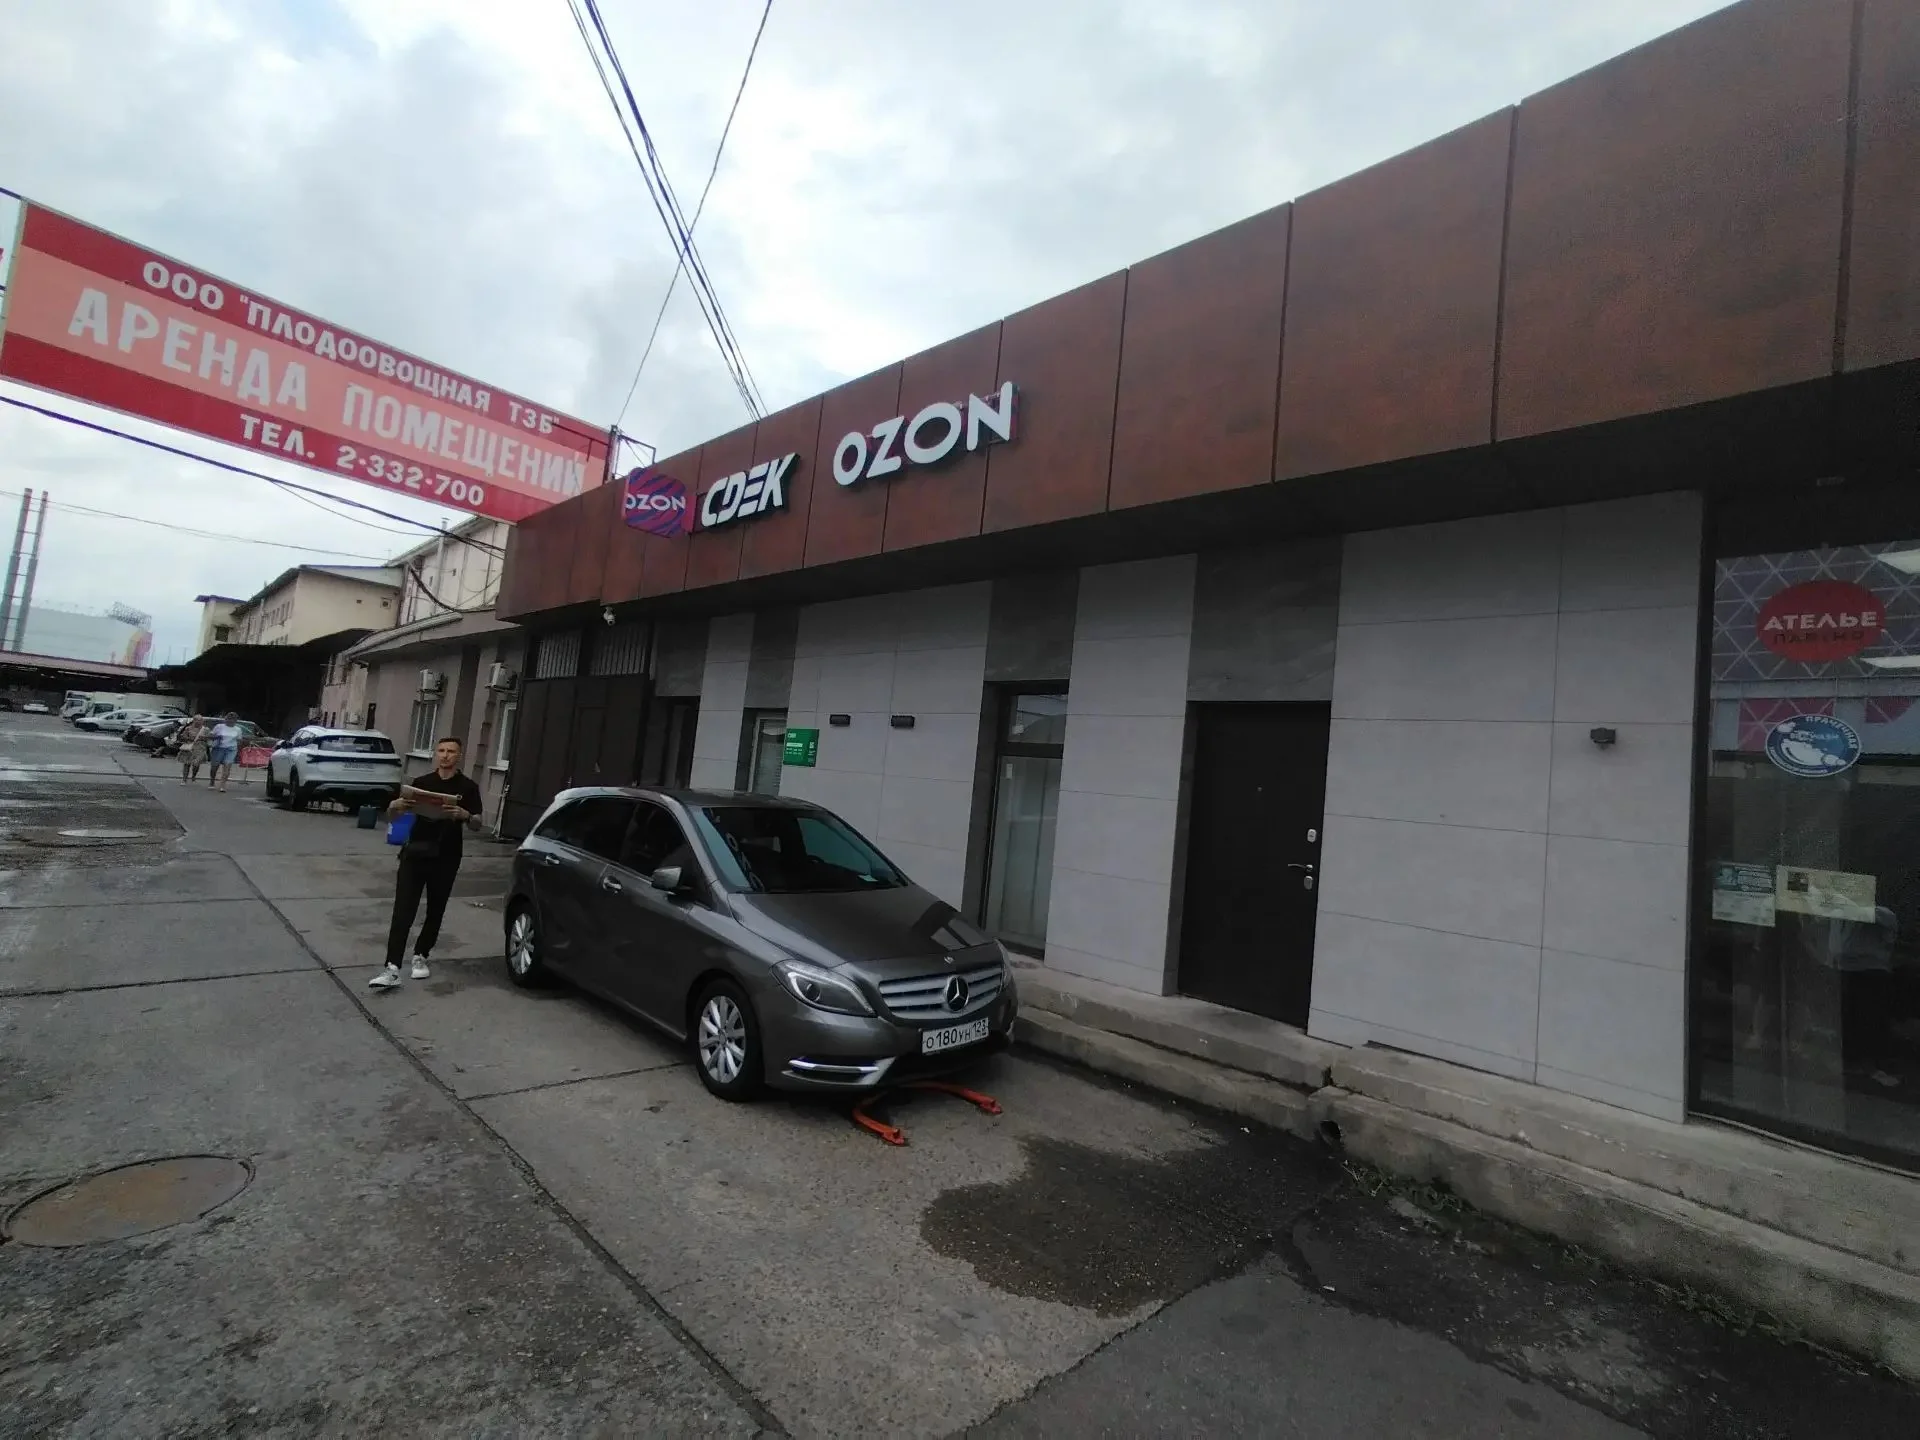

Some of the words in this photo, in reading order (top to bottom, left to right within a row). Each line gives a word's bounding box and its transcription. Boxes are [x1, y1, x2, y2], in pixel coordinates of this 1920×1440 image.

[143, 261, 224, 311] ООО
[67, 287, 308, 412] АРЕНДА
[240, 413, 316, 459] ТЕЛ.
[833, 381, 1013, 486] OZON
[1763, 611, 1878, 631] АТЕЛЬЕ
